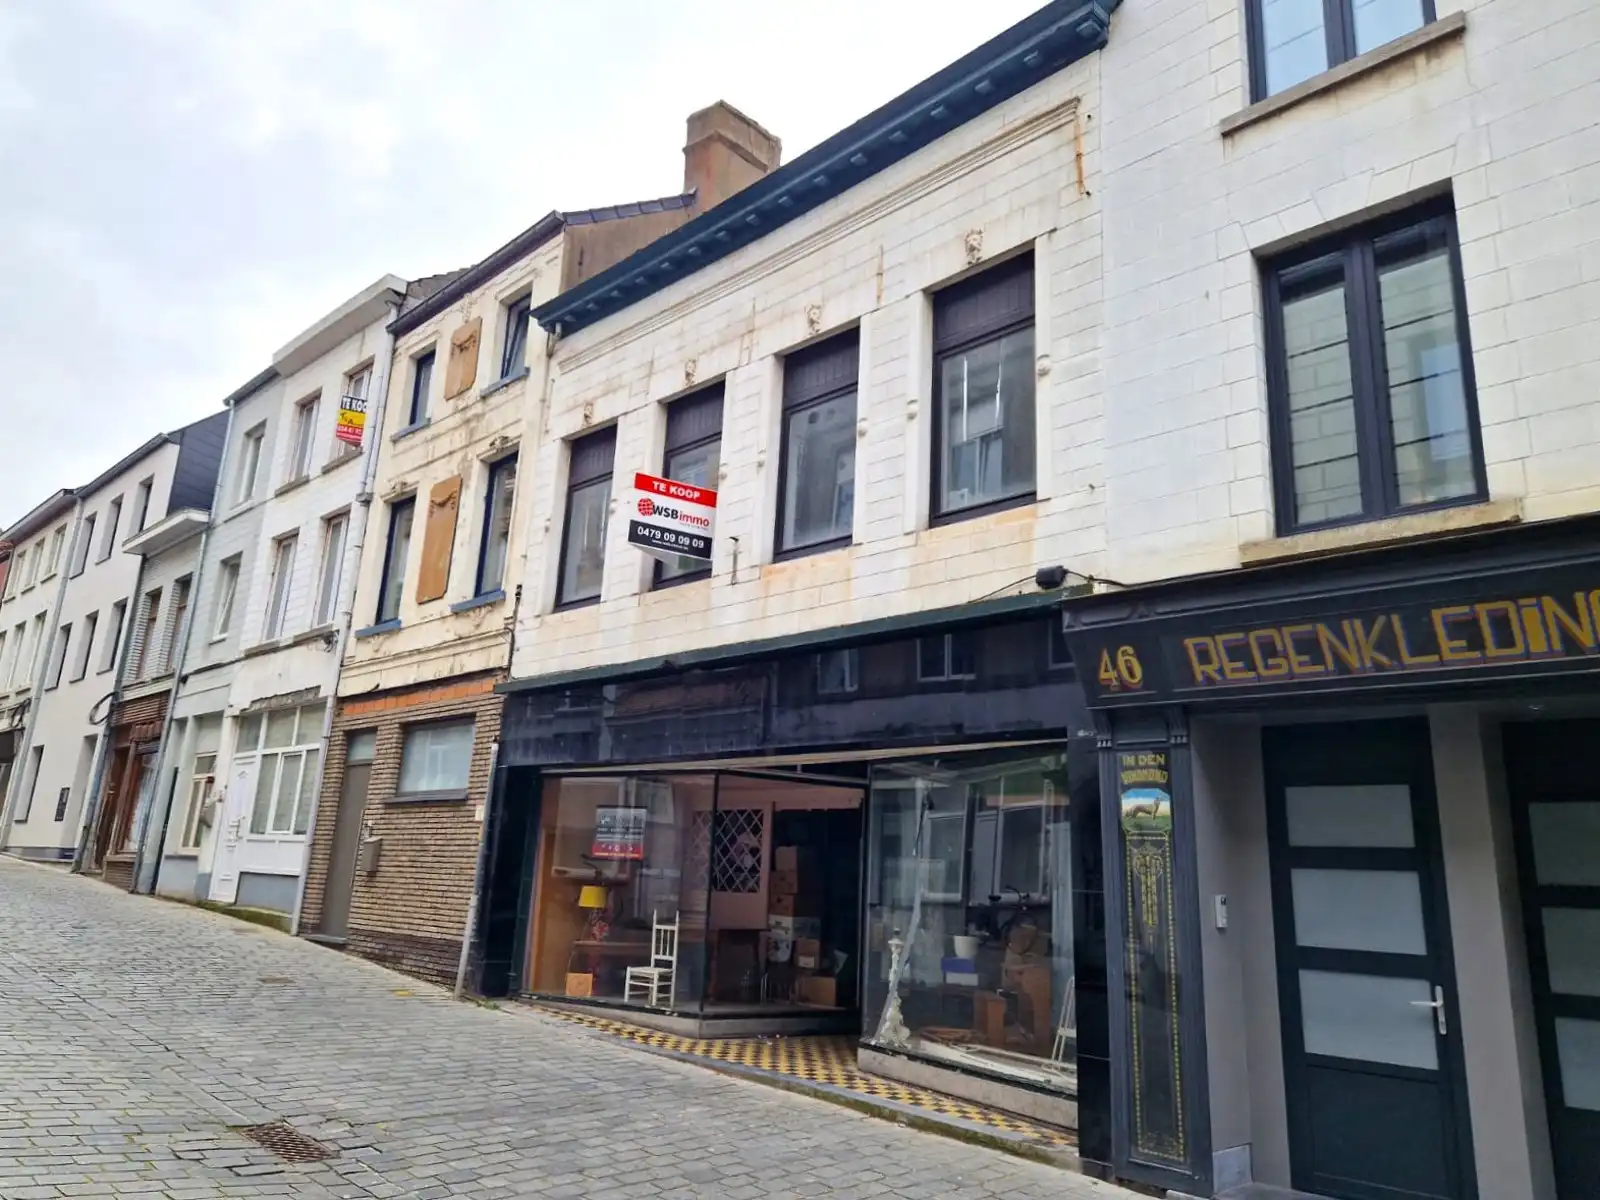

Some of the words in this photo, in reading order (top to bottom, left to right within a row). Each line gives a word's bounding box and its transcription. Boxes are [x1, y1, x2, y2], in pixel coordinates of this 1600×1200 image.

[342, 397, 351, 409] TE
[652, 480, 667, 492] TE
[669, 485, 701, 499] KOOP
[637, 526, 661, 539] 0479
[664, 532, 676, 543] 09
[677, 535, 690, 546] 09
[692, 539, 705, 549] 09
[1097, 644, 1144, 691] 46
